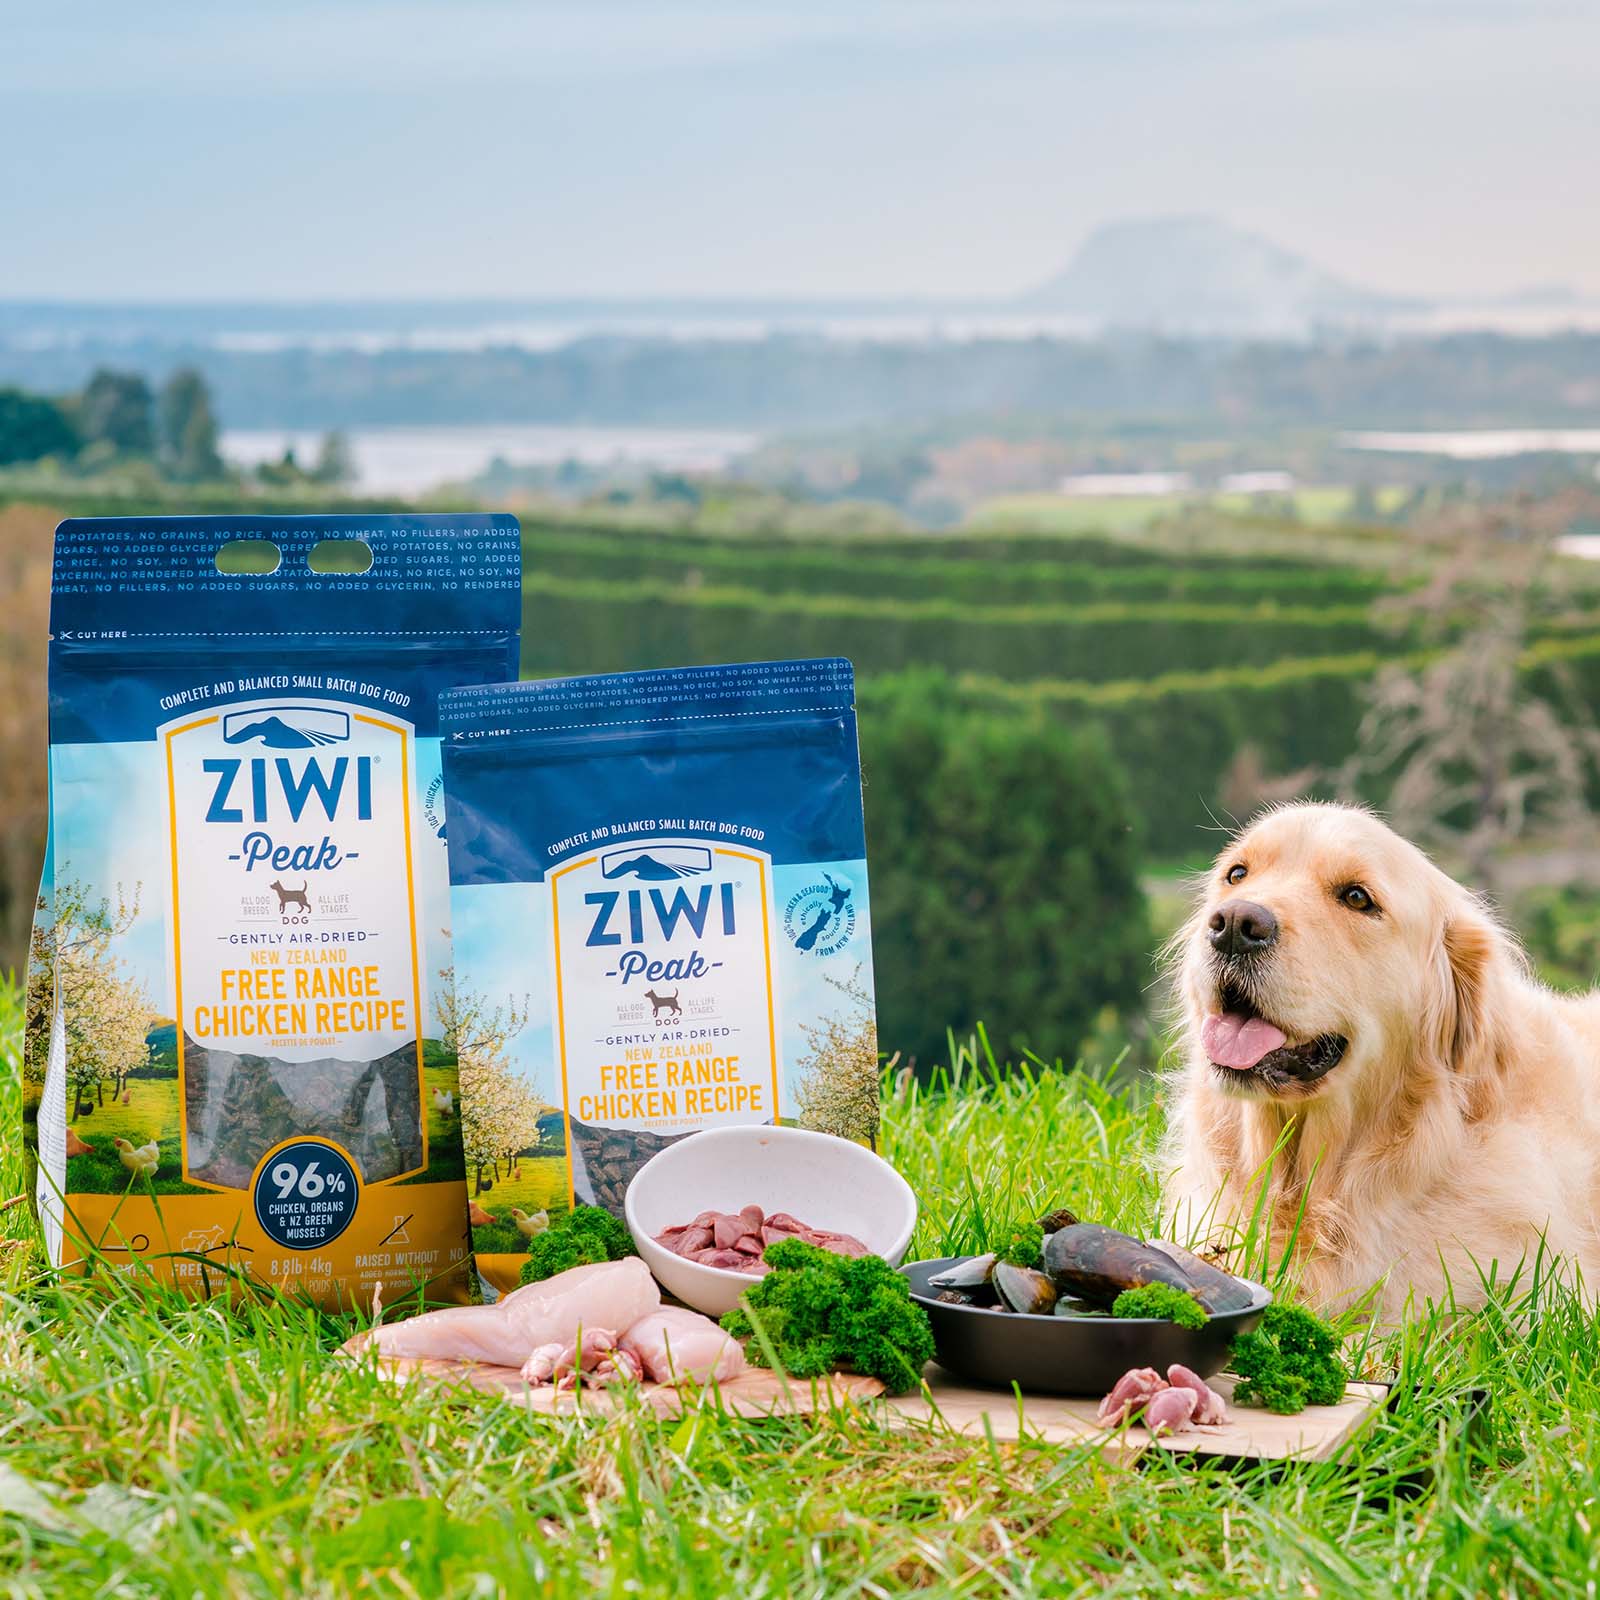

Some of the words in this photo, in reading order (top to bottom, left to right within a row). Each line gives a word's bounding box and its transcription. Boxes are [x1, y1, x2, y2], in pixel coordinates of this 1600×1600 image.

[70, 533, 134, 541] POTATOES,
[140, 532, 154, 540] NO
[162, 532, 208, 540] GRAINS,
[215, 531, 231, 539] NO
[236, 531, 266, 539] RICE,
[272, 531, 288, 539] NO
[294, 531, 318, 539] SOY,
[324, 531, 340, 539] NO
[345, 530, 387, 539] WHEAT,
[392, 530, 407, 538] NO
[413, 529, 459, 538] FILLERS,
[464, 529, 479, 537] NO
[484, 529, 520, 537] ADDED
[103, 545, 119, 553] NO
[127, 545, 164, 553] ADDED
[373, 543, 388, 551] NO
[394, 542, 452, 551] POTATOES,
[458, 542, 473, 550] NO
[478, 541, 520, 550] GRAINS,
[72, 559, 102, 567] RICE,
[112, 558, 128, 566] NO
[137, 558, 163, 566] SOY,
[407, 556, 453, 564] SUGARS,
[462, 555, 476, 563] NO
[485, 555, 520, 563] ADDED
[111, 571, 127, 579] NO
[132, 570, 194, 579] RENDERED
[407, 569, 423, 577] NO
[427, 569, 456, 577] RICE,
[460, 568, 474, 576] NO
[479, 568, 502, 577] SOY,
[506, 568, 520, 576] NO
[96, 584, 112, 592] NO
[120, 583, 170, 592] FILLERS,
[178, 583, 194, 591] NO
[201, 583, 242, 591] ADDED
[249, 583, 299, 591] SUGARS,
[306, 582, 322, 590] NO
[329, 582, 369, 590] ADDED
[377, 582, 436, 591] GLYCERIN,
[443, 582, 458, 590] NO
[465, 581, 520, 589] RENDERED
[102, 631, 127, 639] HERE
[448, 689, 492, 698] POTATOES,
[510, 685, 544, 694] GRAINS,
[561, 681, 583, 689] RICE,
[638, 675, 669, 683] WHEAT,
[687, 671, 723, 679] FILLERS,
[492, 697, 535, 705] RENDERED
[538, 693, 569, 702] MEALS,
[586, 689, 631, 698] POTATOES,
[648, 685, 682, 693] GRAINS,
[698, 681, 720, 689] RICE,
[772, 676, 804, 684] WHEAT,
[160, 686, 211, 710] COMPLETE
[214, 680, 235, 696] AND
[239, 676, 289, 691] BALANCED
[293, 676, 323, 689] SMALL
[327, 678, 357, 693] BATCH
[360, 683, 382, 698] DOG
[384, 689, 411, 708] FOOD
[448, 712, 477, 720] ADDED
[479, 709, 515, 718] SUGARS,
[533, 705, 561, 713] ADDED
[564, 701, 608, 711] GLYCERIN,
[625, 697, 668, 705] RENDERED
[672, 694, 703, 702] MEALS,
[720, 689, 767, 698] POTATOES,
[783, 686, 818, 694] GRAINS,
[489, 729, 511, 737] HERE
[202, 756, 372, 823] ZIWI
[424, 810, 440, 829] 100%
[548, 832, 590, 857] COMPLETE
[592, 827, 609, 841] AND
[612, 820, 656, 836] BALANCED
[659, 820, 686, 830] SMALL
[689, 820, 716, 832] BATCH
[719, 822, 738, 834] DOG
[740, 826, 765, 841] FOOD
[241, 897, 254, 905] ALL
[255, 896, 271, 905] DOG
[318, 896, 332, 904] ALL
[334, 895, 350, 904] LIFE
[244, 906, 270, 915] BREEDS
[321, 905, 348, 914] STAGES
[584, 883, 736, 947] ZIWI
[801, 901, 823, 926] ethically
[282, 917, 309, 925] DOG
[784, 924, 797, 941] 100%
[816, 946, 835, 957] FROM
[835, 935, 849, 951] NEW
[845, 904, 856, 936] ZEALAND
[822, 917, 841, 941] sourced
[230, 934, 283, 944] GENTLY
[290, 932, 367, 944] AIR-DRIED
[251, 951, 280, 965] NEW
[287, 949, 347, 965] ZEALAND
[221, 969, 287, 1001] FREE
[295, 966, 381, 999] RANGE
[617, 1005, 629, 1013] ALL
[689, 999, 701, 1007] ALL
[194, 1004, 307, 1038] CHICKEN
[315, 1000, 406, 1034] RECIPE
[619, 1012, 644, 1021] BREEDS
[656, 1018, 680, 1027] DOG
[606, 1034, 656, 1046] GENTLY
[662, 1028, 730, 1041] AIR-DRIED
[626, 1048, 652, 1062] NEW
[660, 1043, 713, 1059] ZEALAND
[600, 1063, 659, 1091] FREE
[667, 1056, 741, 1087] RANGE
[579, 1091, 676, 1121] CHICKEN
[685, 1085, 763, 1115] RECIPE
[272, 1162, 346, 1199] 96%
[269, 1203, 309, 1215] CHICKEN,
[311, 1202, 344, 1213] ORGANS
[280, 1217, 286, 1227] &
[290, 1216, 301, 1226] NZ
[305, 1215, 333, 1225] GREEN
[287, 1228, 326, 1239] MUSSELS
[356, 1255, 391, 1268] RAISED
[395, 1250, 440, 1265] WITHOUT
[450, 1248, 464, 1261] NO
[271, 1258, 303, 1276] 8.8lb
[310, 1258, 332, 1277] 4kg
